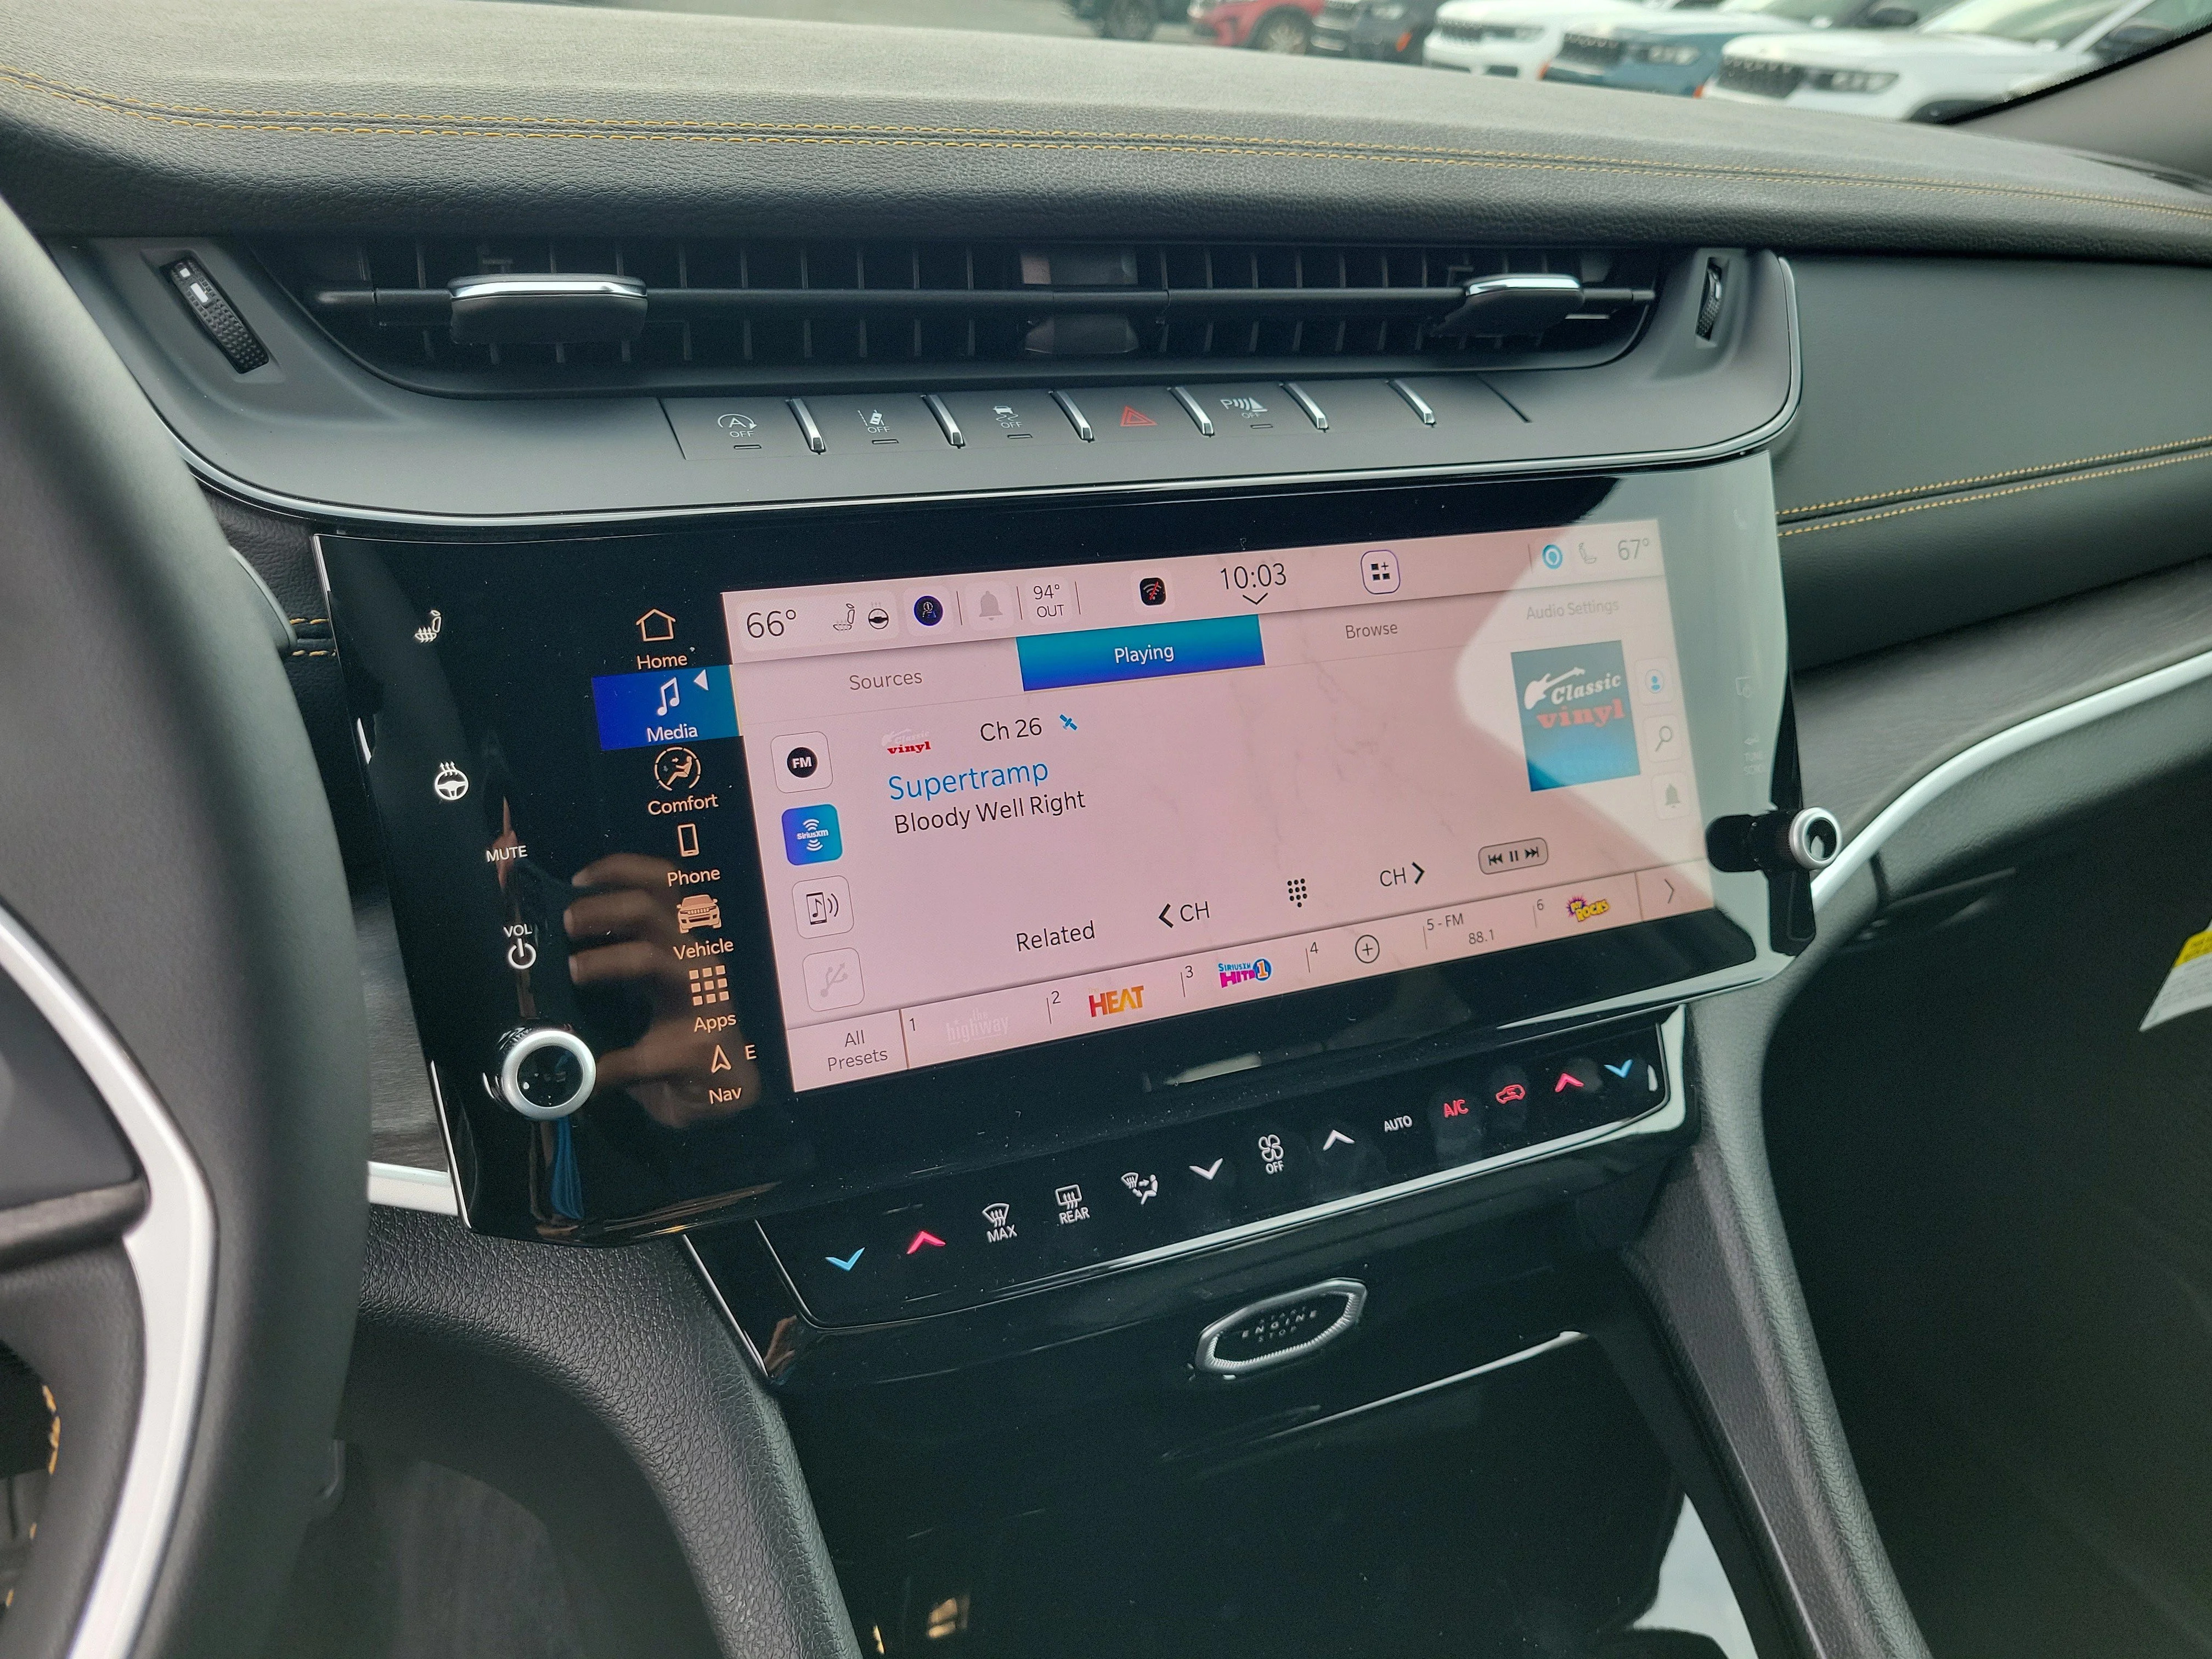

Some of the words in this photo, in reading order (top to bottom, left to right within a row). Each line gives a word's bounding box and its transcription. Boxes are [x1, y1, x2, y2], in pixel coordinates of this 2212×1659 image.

[1617, 538, 1649, 561] 67°
[1220, 563, 1287, 590] 10:03
[1033, 583, 1060, 601] 94°
[1036, 604, 1064, 618] OUT
[1526, 605, 1564, 620] Audio
[1567, 599, 1620, 616] Settings
[746, 609, 797, 639] 66°
[1345, 622, 1398, 639] Browse
[637, 654, 687, 670] Home
[1114, 645, 1175, 664] Playing
[849, 669, 922, 691] Sources
[1551, 672, 1622, 705] Classic
[1536, 698, 1625, 729] vinyl
[647, 724, 698, 742] Media
[980, 720, 1010, 742] Ch
[1016, 717, 1042, 739] 26
[887, 741, 931, 755] vinyl
[792, 756, 812, 769] FM
[888, 761, 1048, 801] Supertramp
[648, 794, 719, 815] Comfort
[894, 806, 970, 834] Bloody
[976, 799, 1024, 822] Well
[1030, 791, 1086, 815] Right
[486, 845, 528, 862] MUTE
[667, 869, 720, 887] Phone
[1379, 867, 1407, 888] CH
[1179, 901, 1211, 923] CH
[1536, 899, 1544, 910] 6
[1426, 918, 1434, 930] 5
[1445, 913, 1464, 927] FM
[504, 924, 532, 938] VOL
[1017, 920, 1096, 952] Related
[1469, 929, 1494, 944] 88.1
[673, 938, 734, 960] Vehicle
[1310, 941, 1318, 953] 4
[1185, 966, 1194, 978] 3
[1052, 991, 1061, 1004] 2
[1088, 985, 1144, 1017] HEAT
[694, 1013, 737, 1033] Apps
[910, 1018, 916, 1031] 1
[946, 1017, 1009, 1042] highway
[844, 1030, 865, 1047] All
[744, 1045, 757, 1060] E
[828, 1048, 888, 1072] Presets
[709, 1087, 742, 1104] Nav
[1443, 1099, 1469, 1118] A/C
[1384, 1115, 1413, 1132] AUTO
[1266, 1160, 1284, 1173] OFF
[1058, 1207, 1090, 1225] REAR
[988, 1225, 1017, 1243] MAX
[1241, 1309, 1317, 1338] ENGINE
